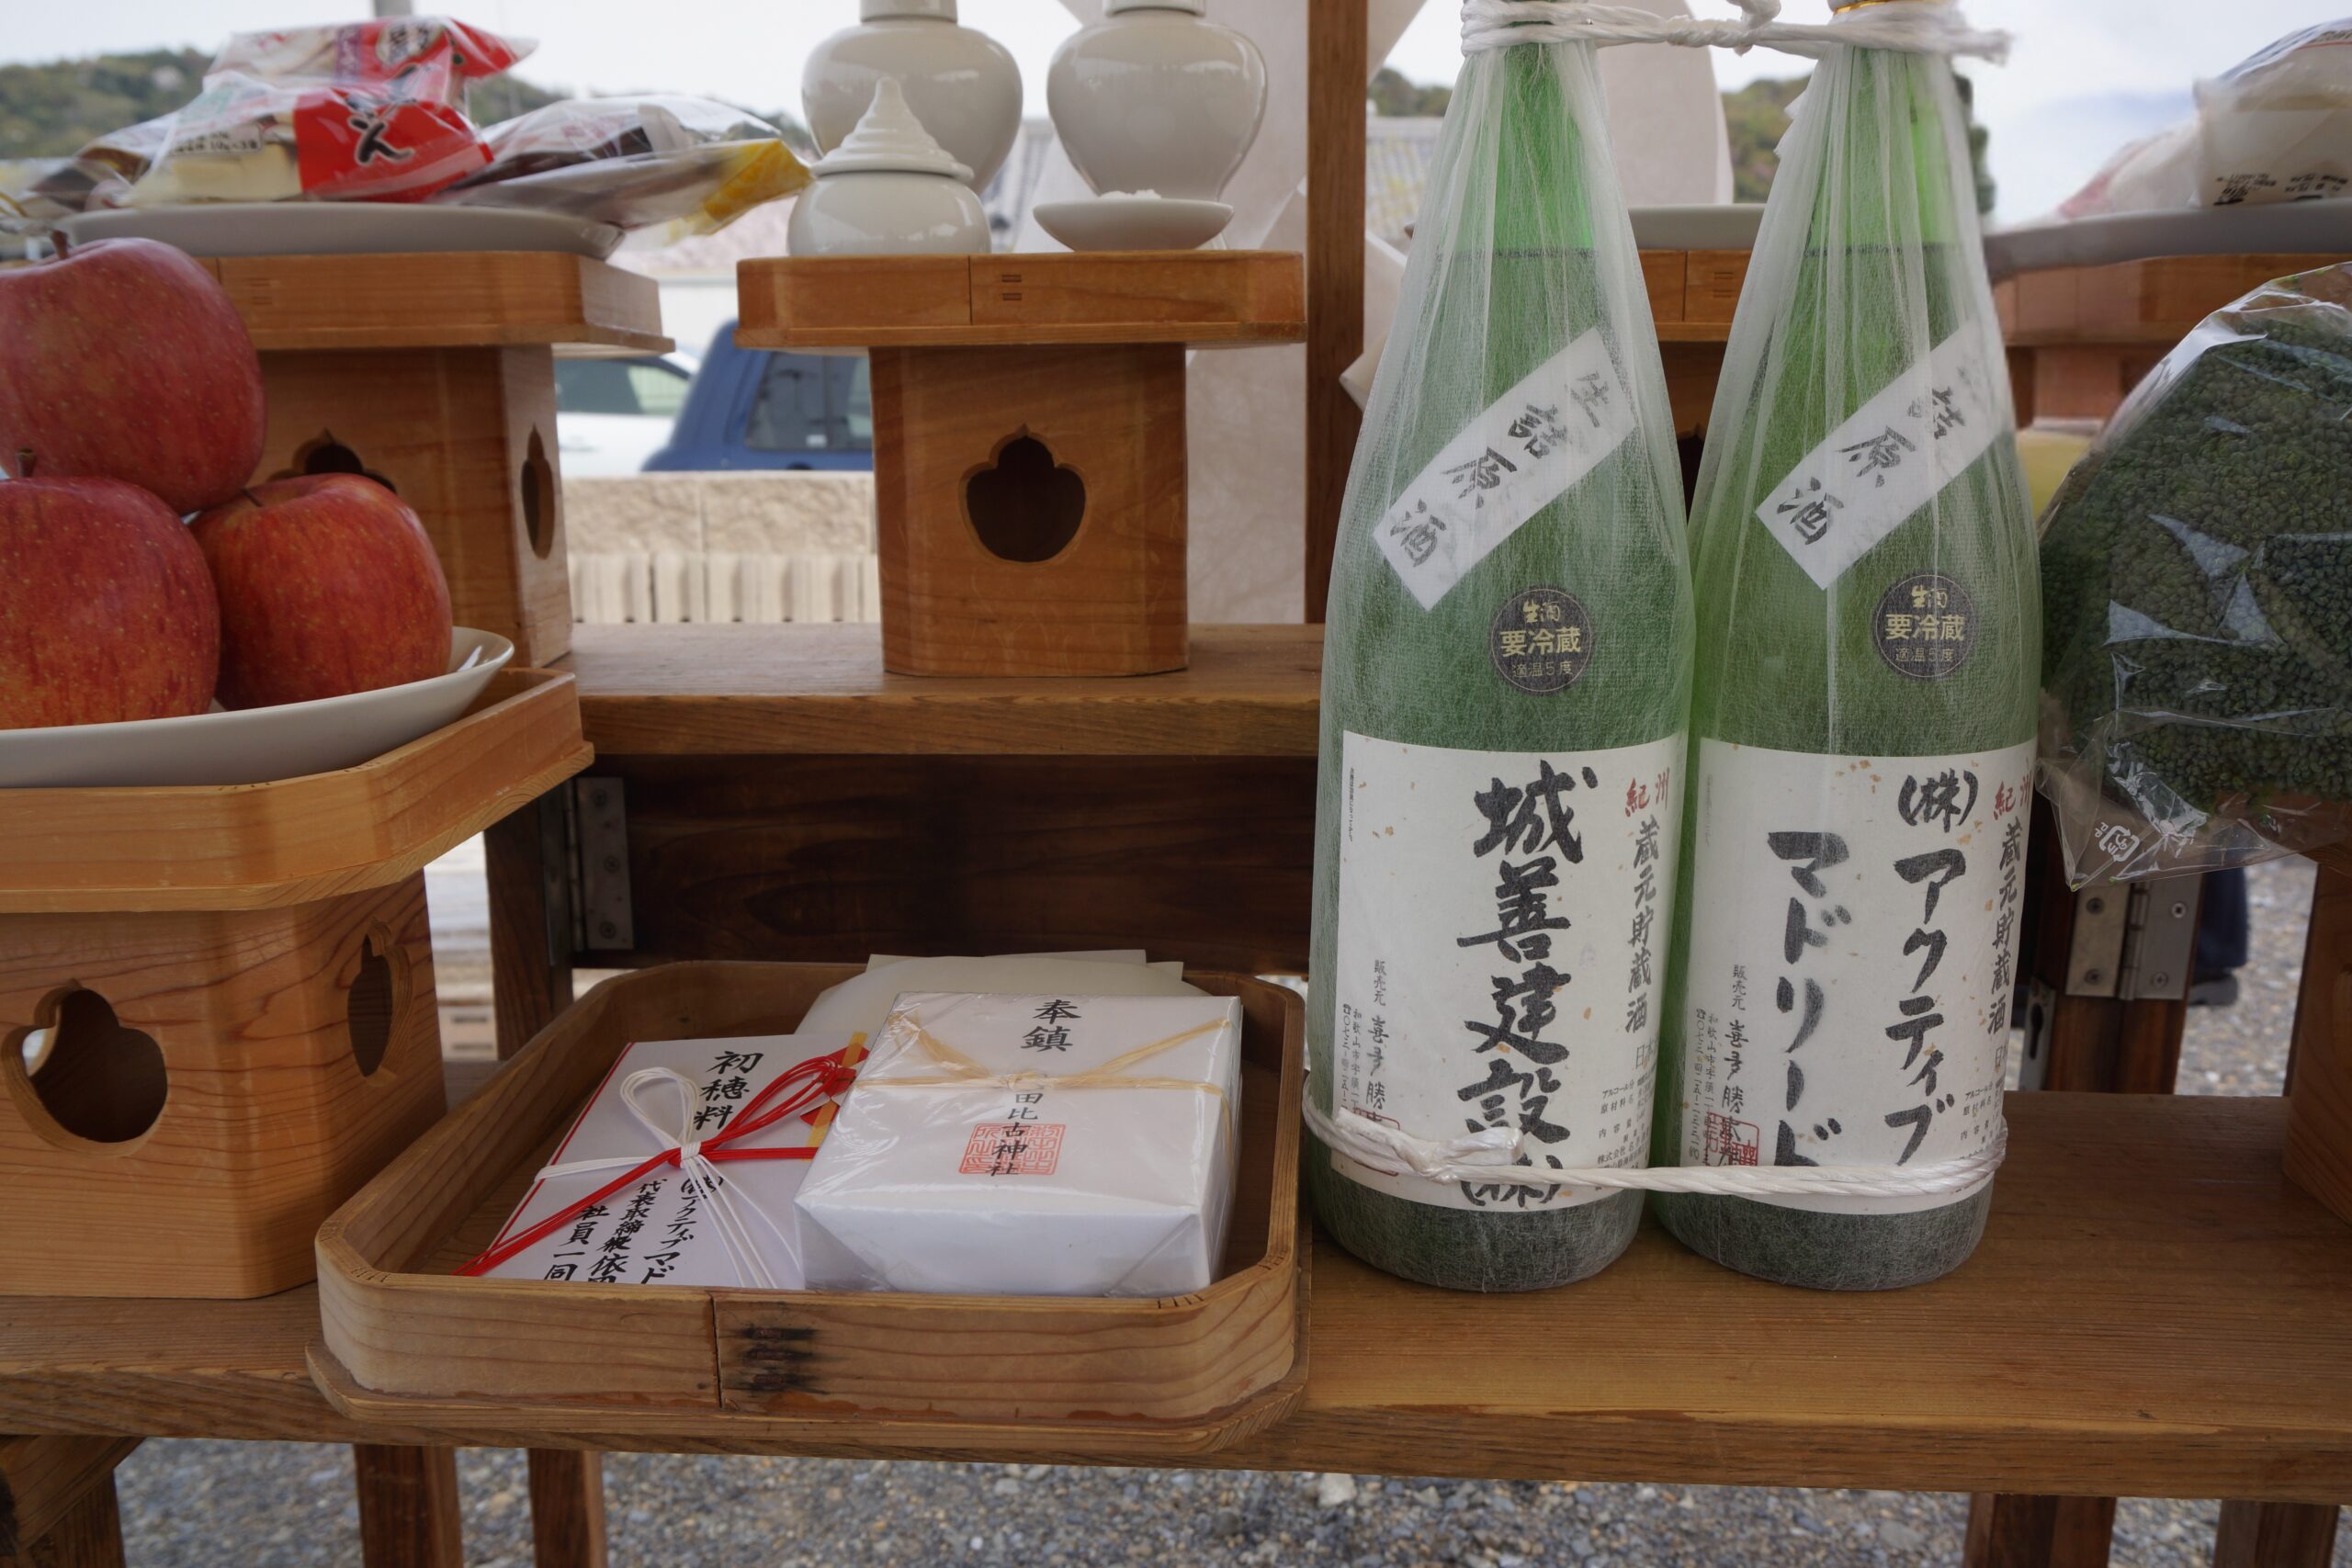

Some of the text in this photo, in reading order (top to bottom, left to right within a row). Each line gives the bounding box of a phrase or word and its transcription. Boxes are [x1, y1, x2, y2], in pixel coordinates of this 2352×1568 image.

[1499, 626, 1582, 658] 要冷蔵
[1885, 614, 1965, 641] 要冷蔵
[1624, 814, 1660, 1034] 蔵元貯蔵酒
[1987, 816, 2023, 1035] 蔵元貯蔵酒
[1020, 998, 1082, 1053] 奉鎮
[694, 1050, 765, 1131] 初穂料
[986, 1089, 1045, 1177] 田比古神社
[543, 1205, 611, 1281] 社員一同
